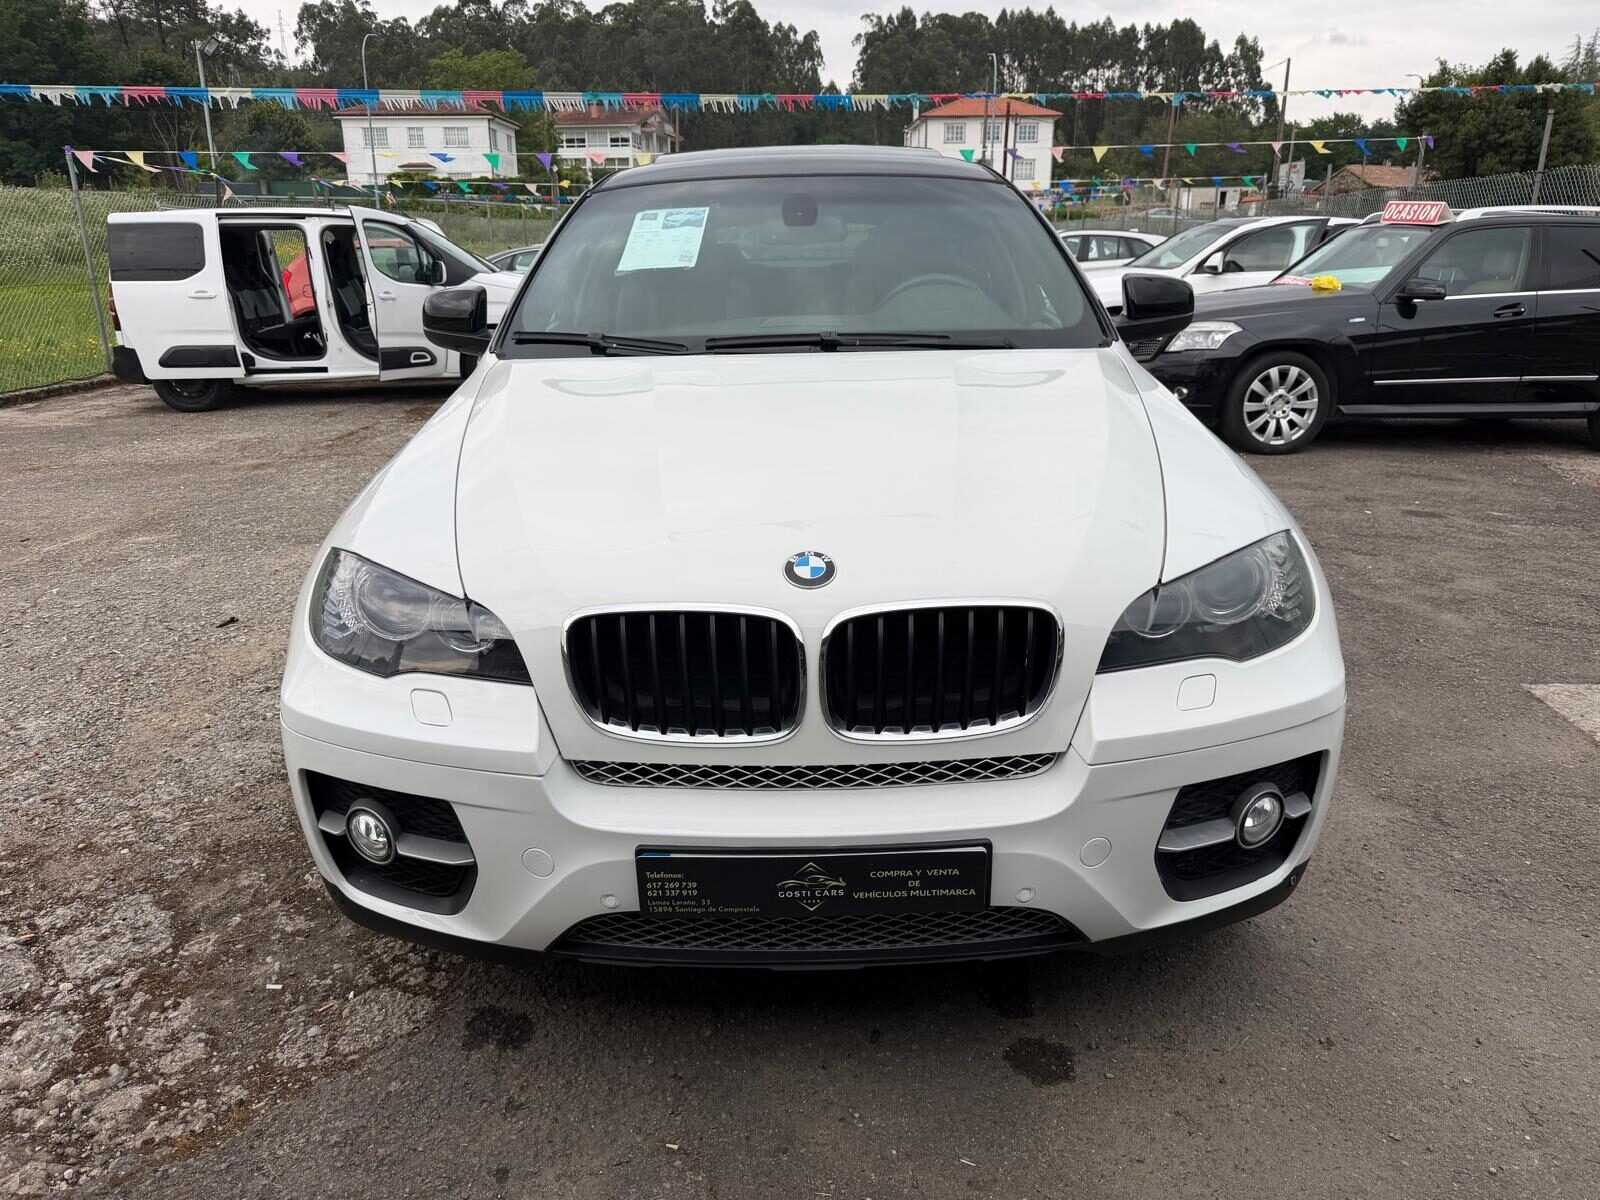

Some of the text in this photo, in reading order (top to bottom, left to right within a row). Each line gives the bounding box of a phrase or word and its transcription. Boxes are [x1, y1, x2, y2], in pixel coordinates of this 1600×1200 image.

[1384, 204, 1441, 221] OCASION
[870, 870, 913, 878] COMPRA
[926, 868, 960, 876] VENTA
[778, 889, 845, 898] GOSTI CARS
[852, 888, 977, 899] VEHÍCULOS MULTIMARCA
[718, 905, 760, 913] Compostela
